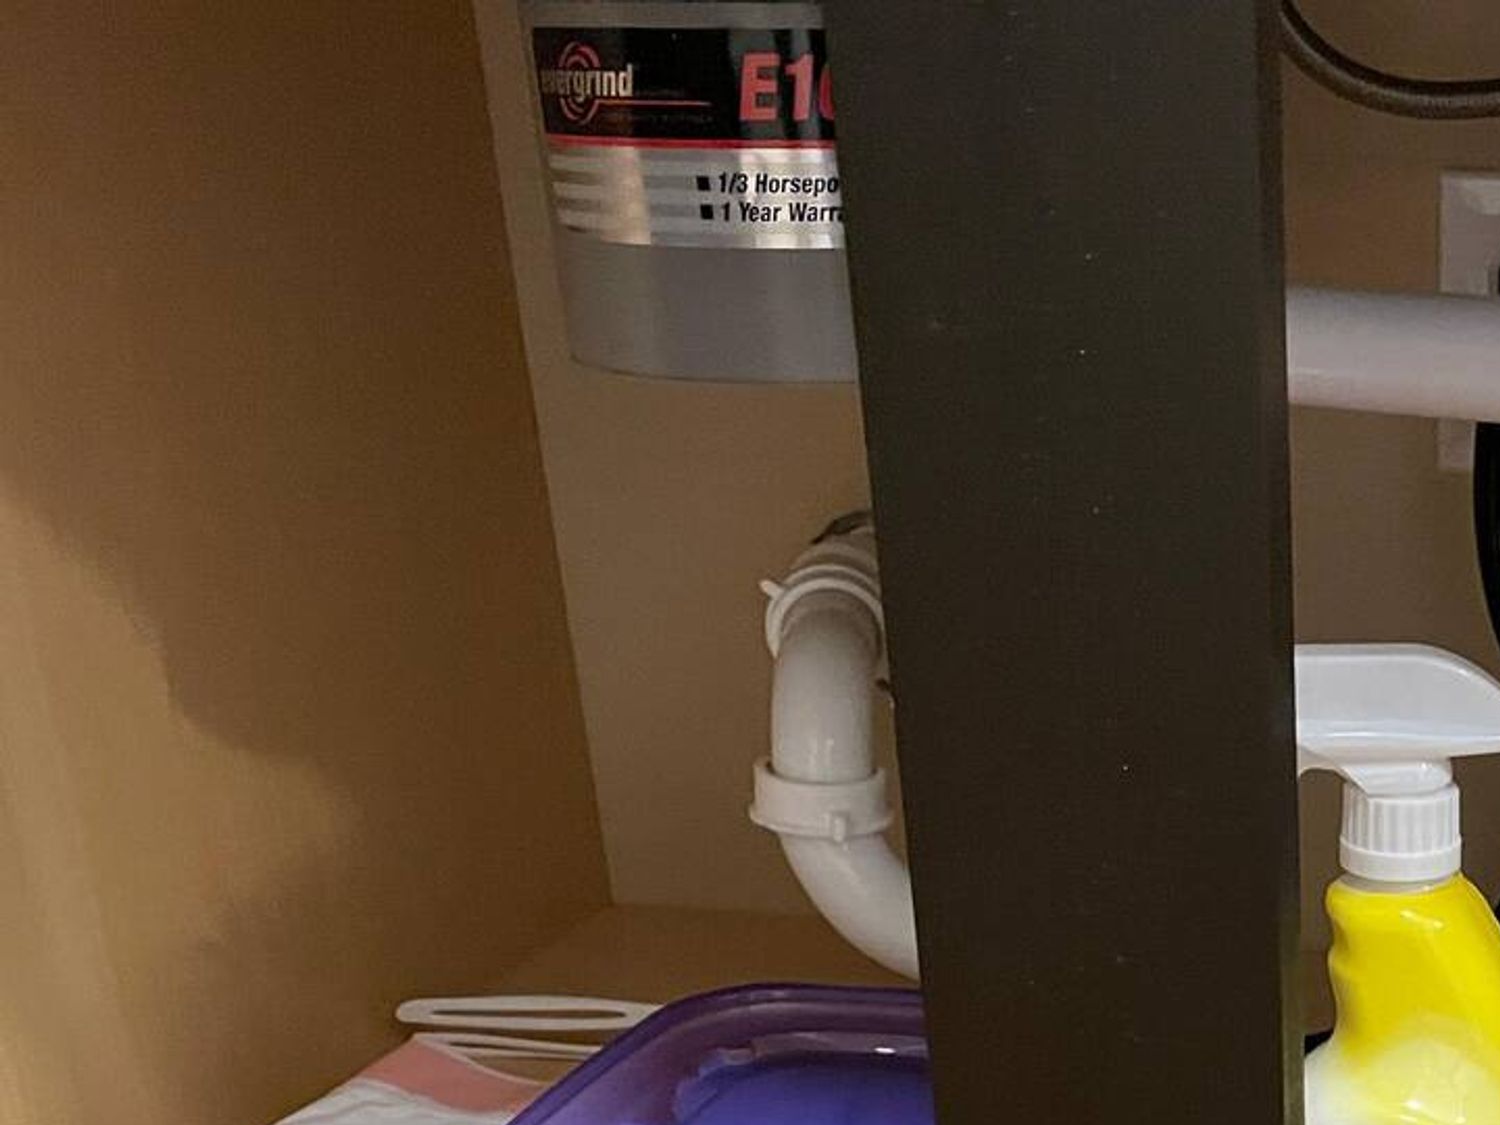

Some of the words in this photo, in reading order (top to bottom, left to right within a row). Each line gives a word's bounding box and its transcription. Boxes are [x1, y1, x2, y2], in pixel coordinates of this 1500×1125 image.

[718, 174, 749, 194] 1/3
[721, 205, 732, 222] 1
[737, 204, 781, 223] Year
